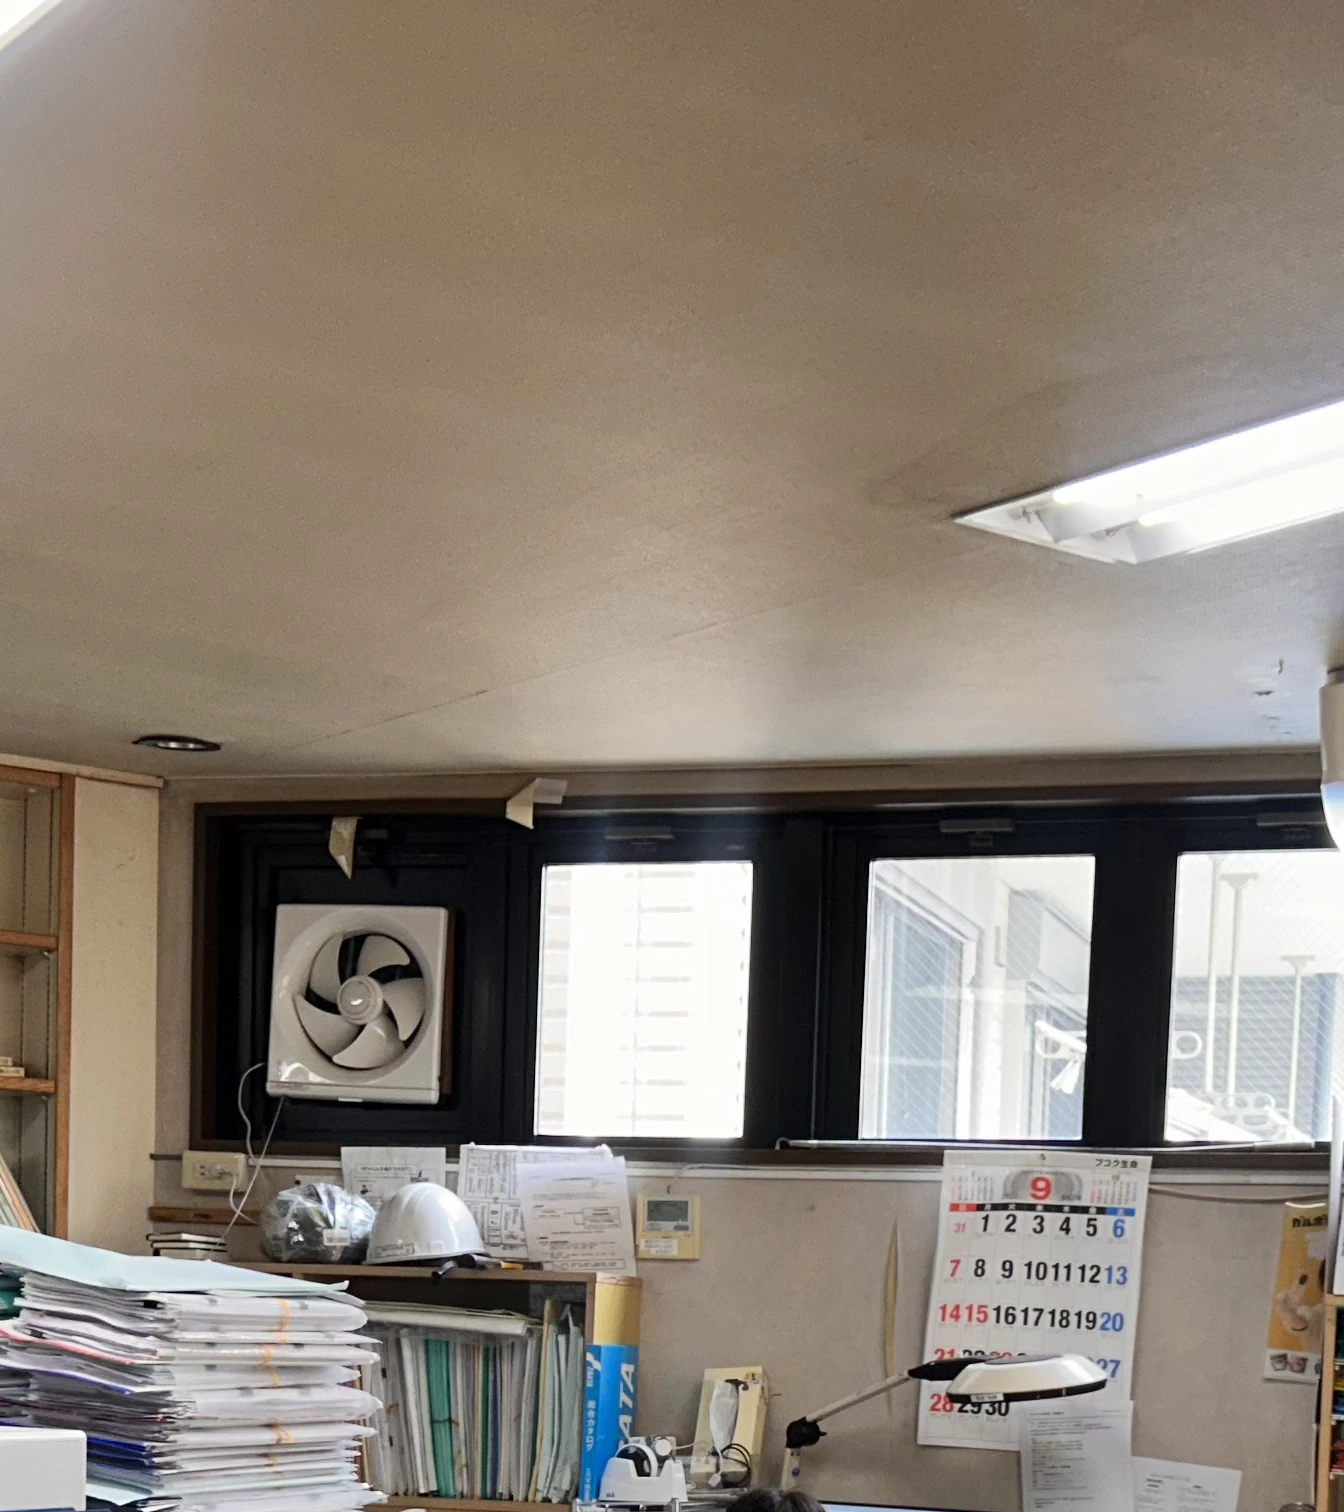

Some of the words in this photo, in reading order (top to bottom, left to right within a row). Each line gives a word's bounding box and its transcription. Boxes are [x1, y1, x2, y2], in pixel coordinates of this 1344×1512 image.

[1030, 1176, 1052, 1201] 9
[981, 1214, 989, 1232] 1
[1004, 1213, 1017, 1233] 2
[1032, 1215, 1045, 1234] 3
[1059, 1216, 1071, 1235] 4
[1086, 1218, 1098, 1237] 5
[1112, 1219, 1125, 1238] 6
[949, 1259, 960, 1277] 7
[973, 1258, 986, 1278] 8
[1001, 1260, 1013, 1279] 9
[1024, 1261, 1047, 1281] 10
[1051, 1262, 1072, 1282] 11
[1078, 1264, 1101, 1284] 12
[1105, 1266, 1128, 1285] 13
[939, 1304, 960, 1323] 14
[965, 1304, 989, 1324] 15
[992, 1305, 1017, 1326] 16
[1020, 1307, 1044, 1327] 17
[1047, 1309, 1071, 1329] 18
[1074, 1310, 1097, 1330] 19
[1099, 1312, 1124, 1332] 20
[929, 1393, 954, 1413] 28
